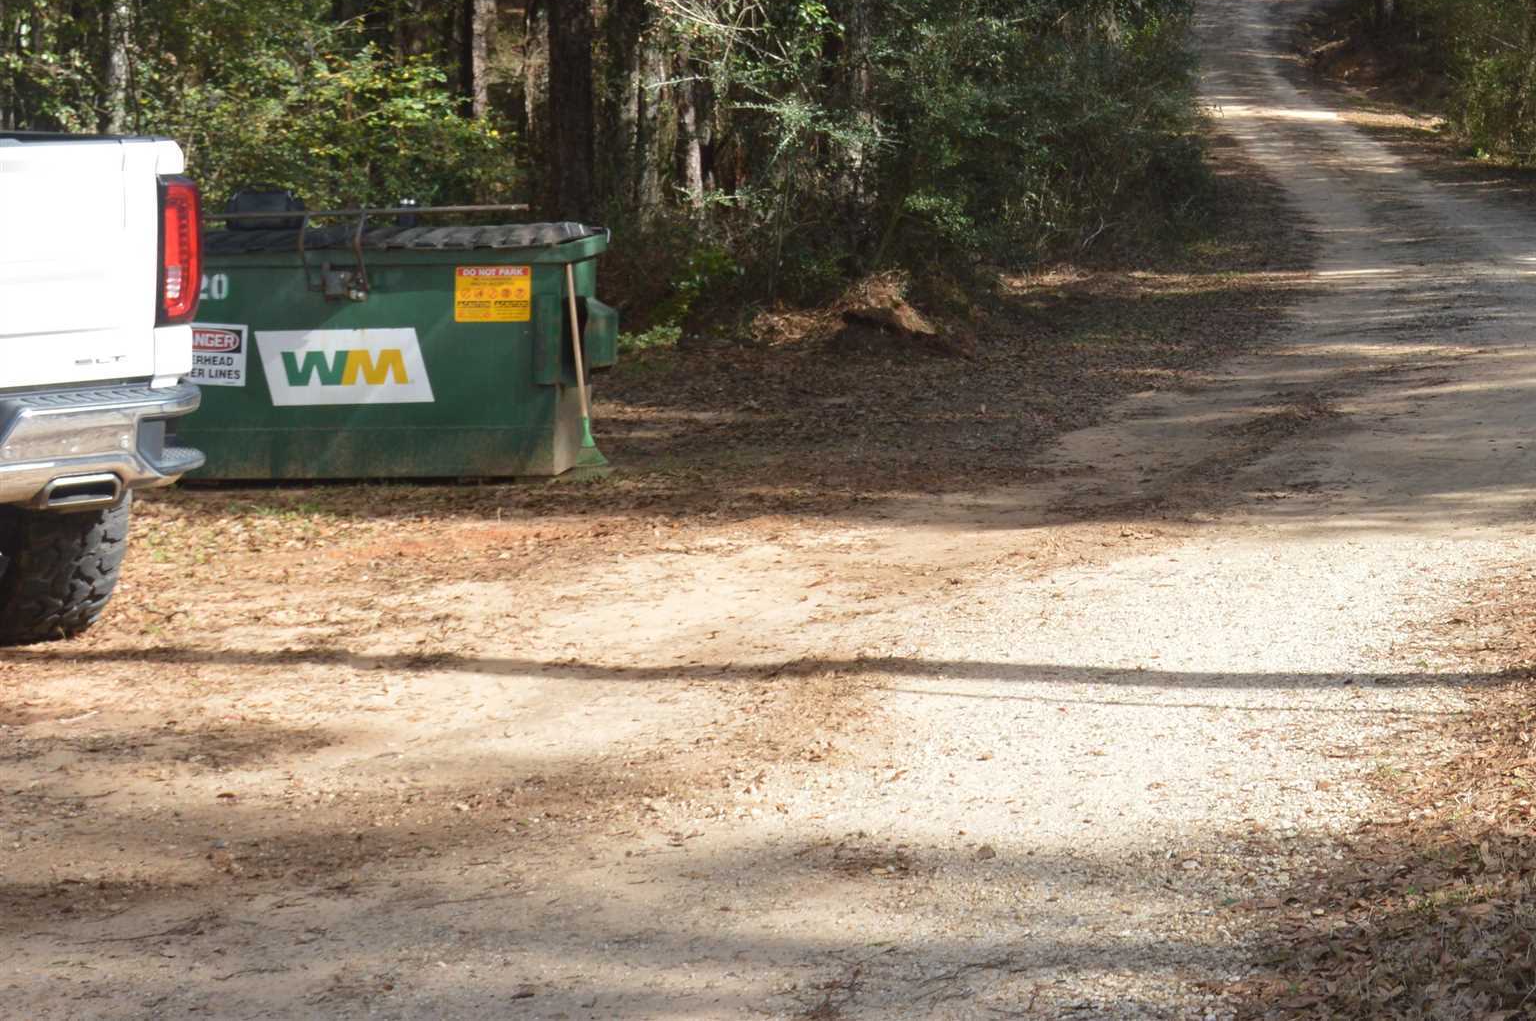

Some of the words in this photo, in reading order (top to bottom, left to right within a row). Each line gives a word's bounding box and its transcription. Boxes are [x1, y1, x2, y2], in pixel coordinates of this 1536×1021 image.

[463, 266, 476, 276] DO
[480, 266, 497, 276] NOT
[499, 266, 523, 276] PARK
[192, 333, 234, 348] NGER
[192, 355, 234, 366] ERHEAD
[280, 349, 409, 387] WM
[209, 369, 241, 380] LINES
